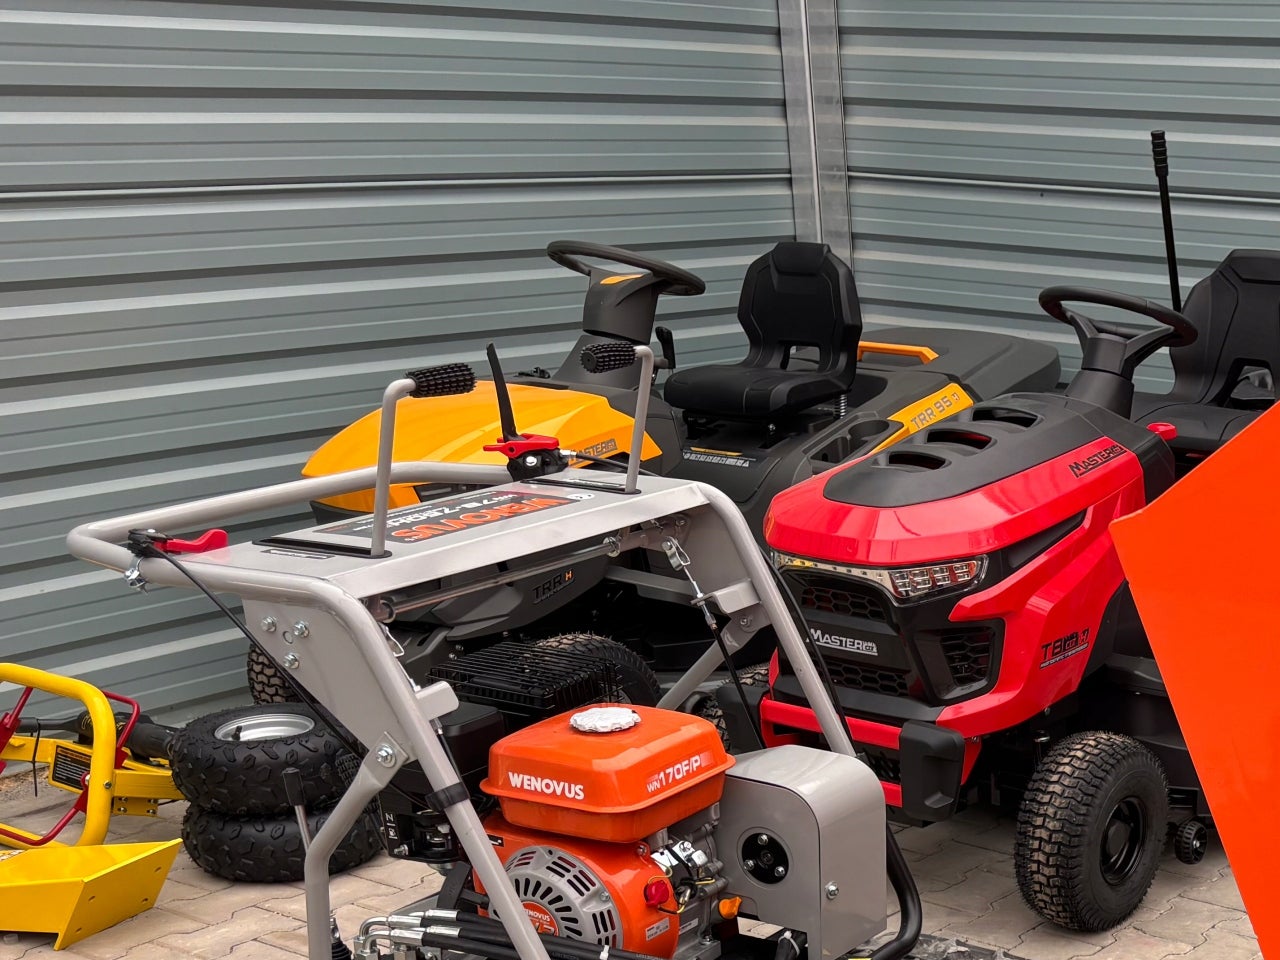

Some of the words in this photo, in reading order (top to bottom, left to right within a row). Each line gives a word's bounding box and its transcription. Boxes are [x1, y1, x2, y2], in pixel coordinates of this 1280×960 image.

[911, 407, 937, 429] TRR
[934, 395, 953, 413] 95
[533, 574, 563, 599] TRR
[565, 570, 573, 581] H
[508, 771, 585, 800] WENOVUS
